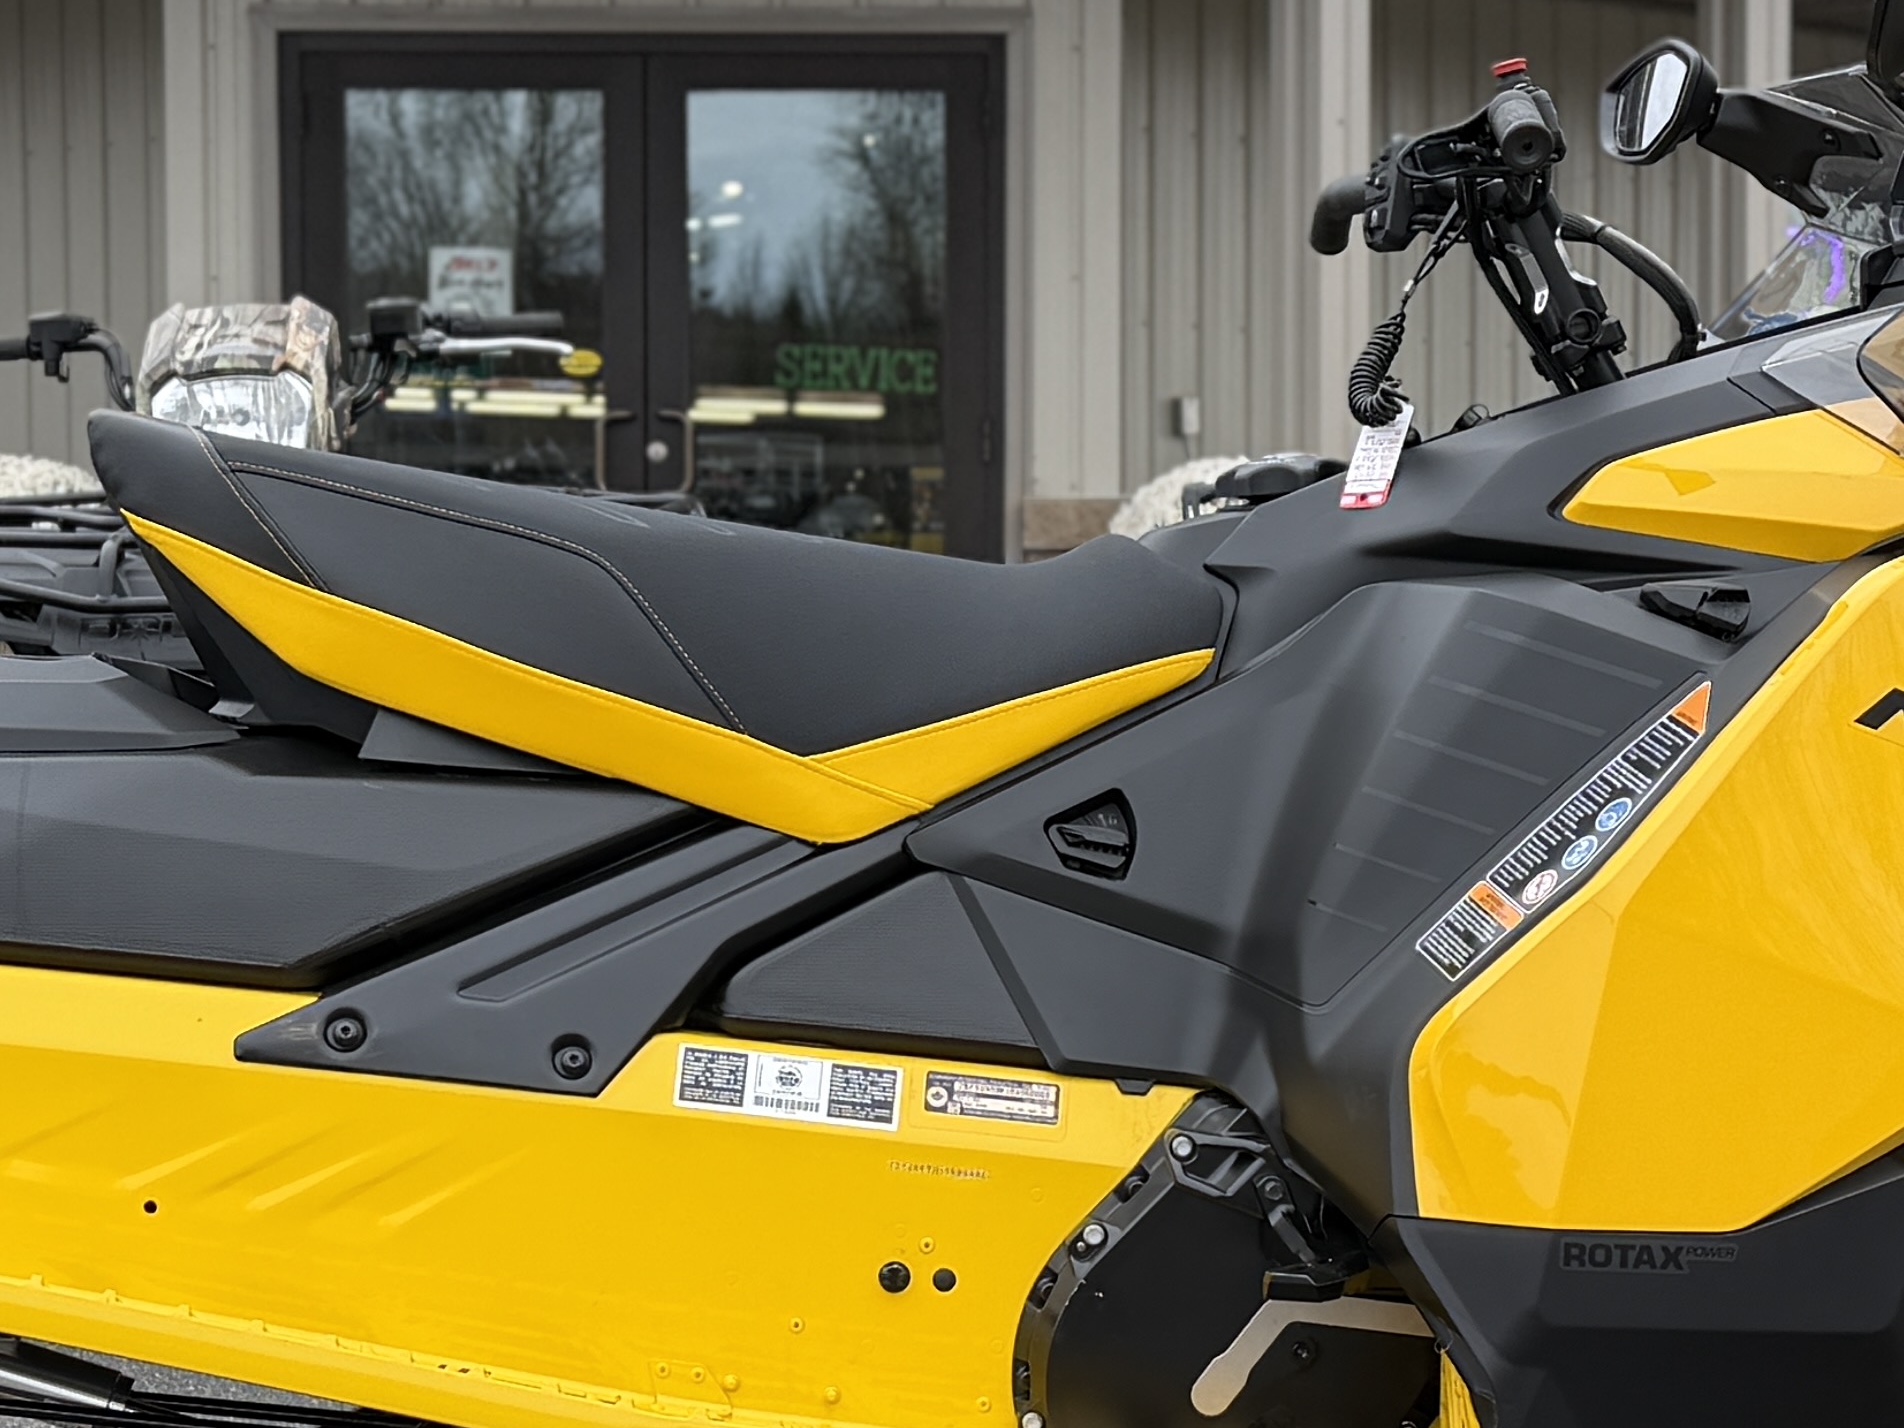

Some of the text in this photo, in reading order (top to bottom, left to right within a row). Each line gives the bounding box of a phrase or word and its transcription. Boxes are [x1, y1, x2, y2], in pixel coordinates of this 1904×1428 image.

[776, 344, 940, 394] SERVICE
[1562, 1241, 1737, 1272] ROTAX POWER
